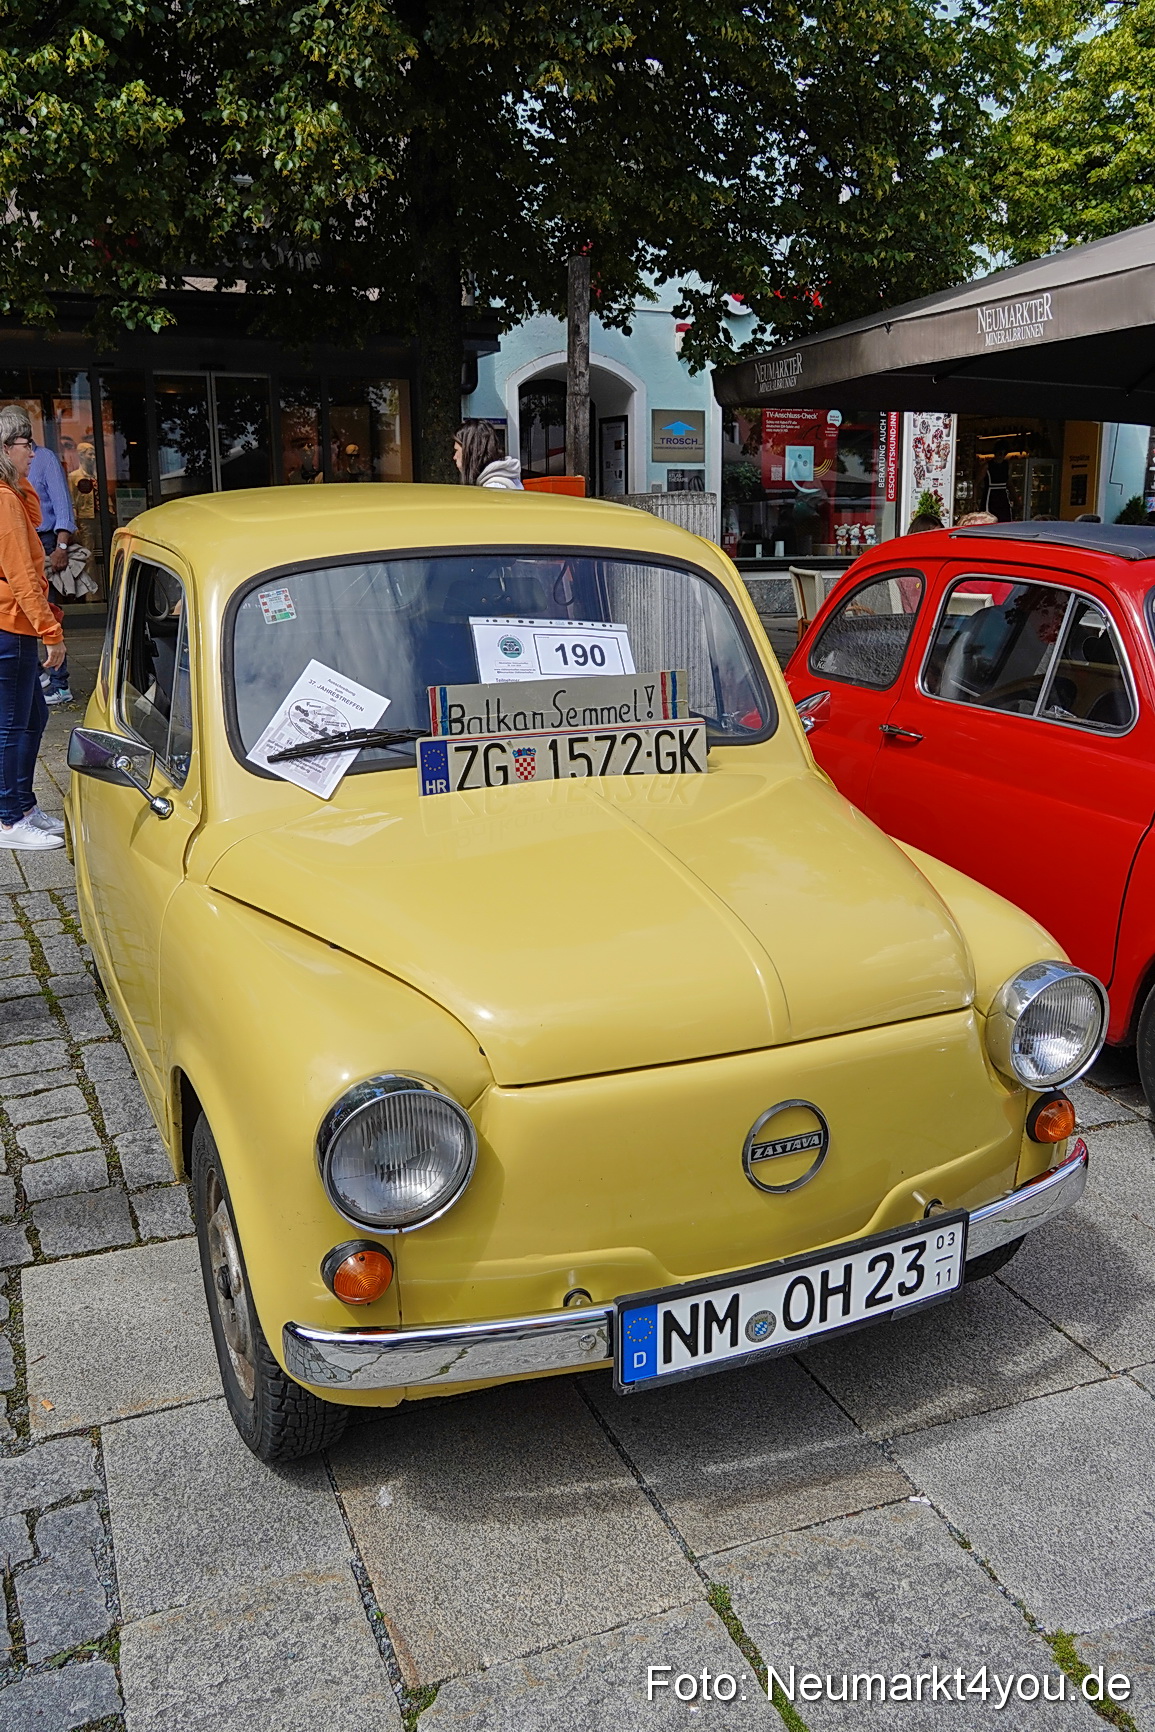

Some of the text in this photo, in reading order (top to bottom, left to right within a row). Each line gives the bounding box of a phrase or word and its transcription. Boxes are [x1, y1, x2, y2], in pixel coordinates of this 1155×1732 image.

[976, 292, 1053, 335] NEUMARKTER
[984, 323, 1044, 347] MINERALBRUNNEN
[754, 352, 803, 384] NEUMARKTER
[758, 375, 797, 393] MINERALBRUNNEN
[660, 437, 698, 445] TROSCH
[879, 419, 887, 442] AUCH
[878, 445, 886, 488] BERATUNG
[554, 643, 606, 667] 190
[308, 679, 365, 712] 37. JAHRESTREFFEN
[448, 685, 655, 736] Balkan Semmel!
[454, 742, 509, 791] ZG
[425, 778, 447, 795] HR
[753, 1135, 820, 1159] ZASTAVA
[936, 1231, 955, 1250] 03
[935, 1267, 952, 1286] 11
[662, 1292, 740, 1365] NM
[782, 1262, 853, 1332] OH
[864, 1239, 927, 1310] 23
[633, 1351, 647, 1369] D
